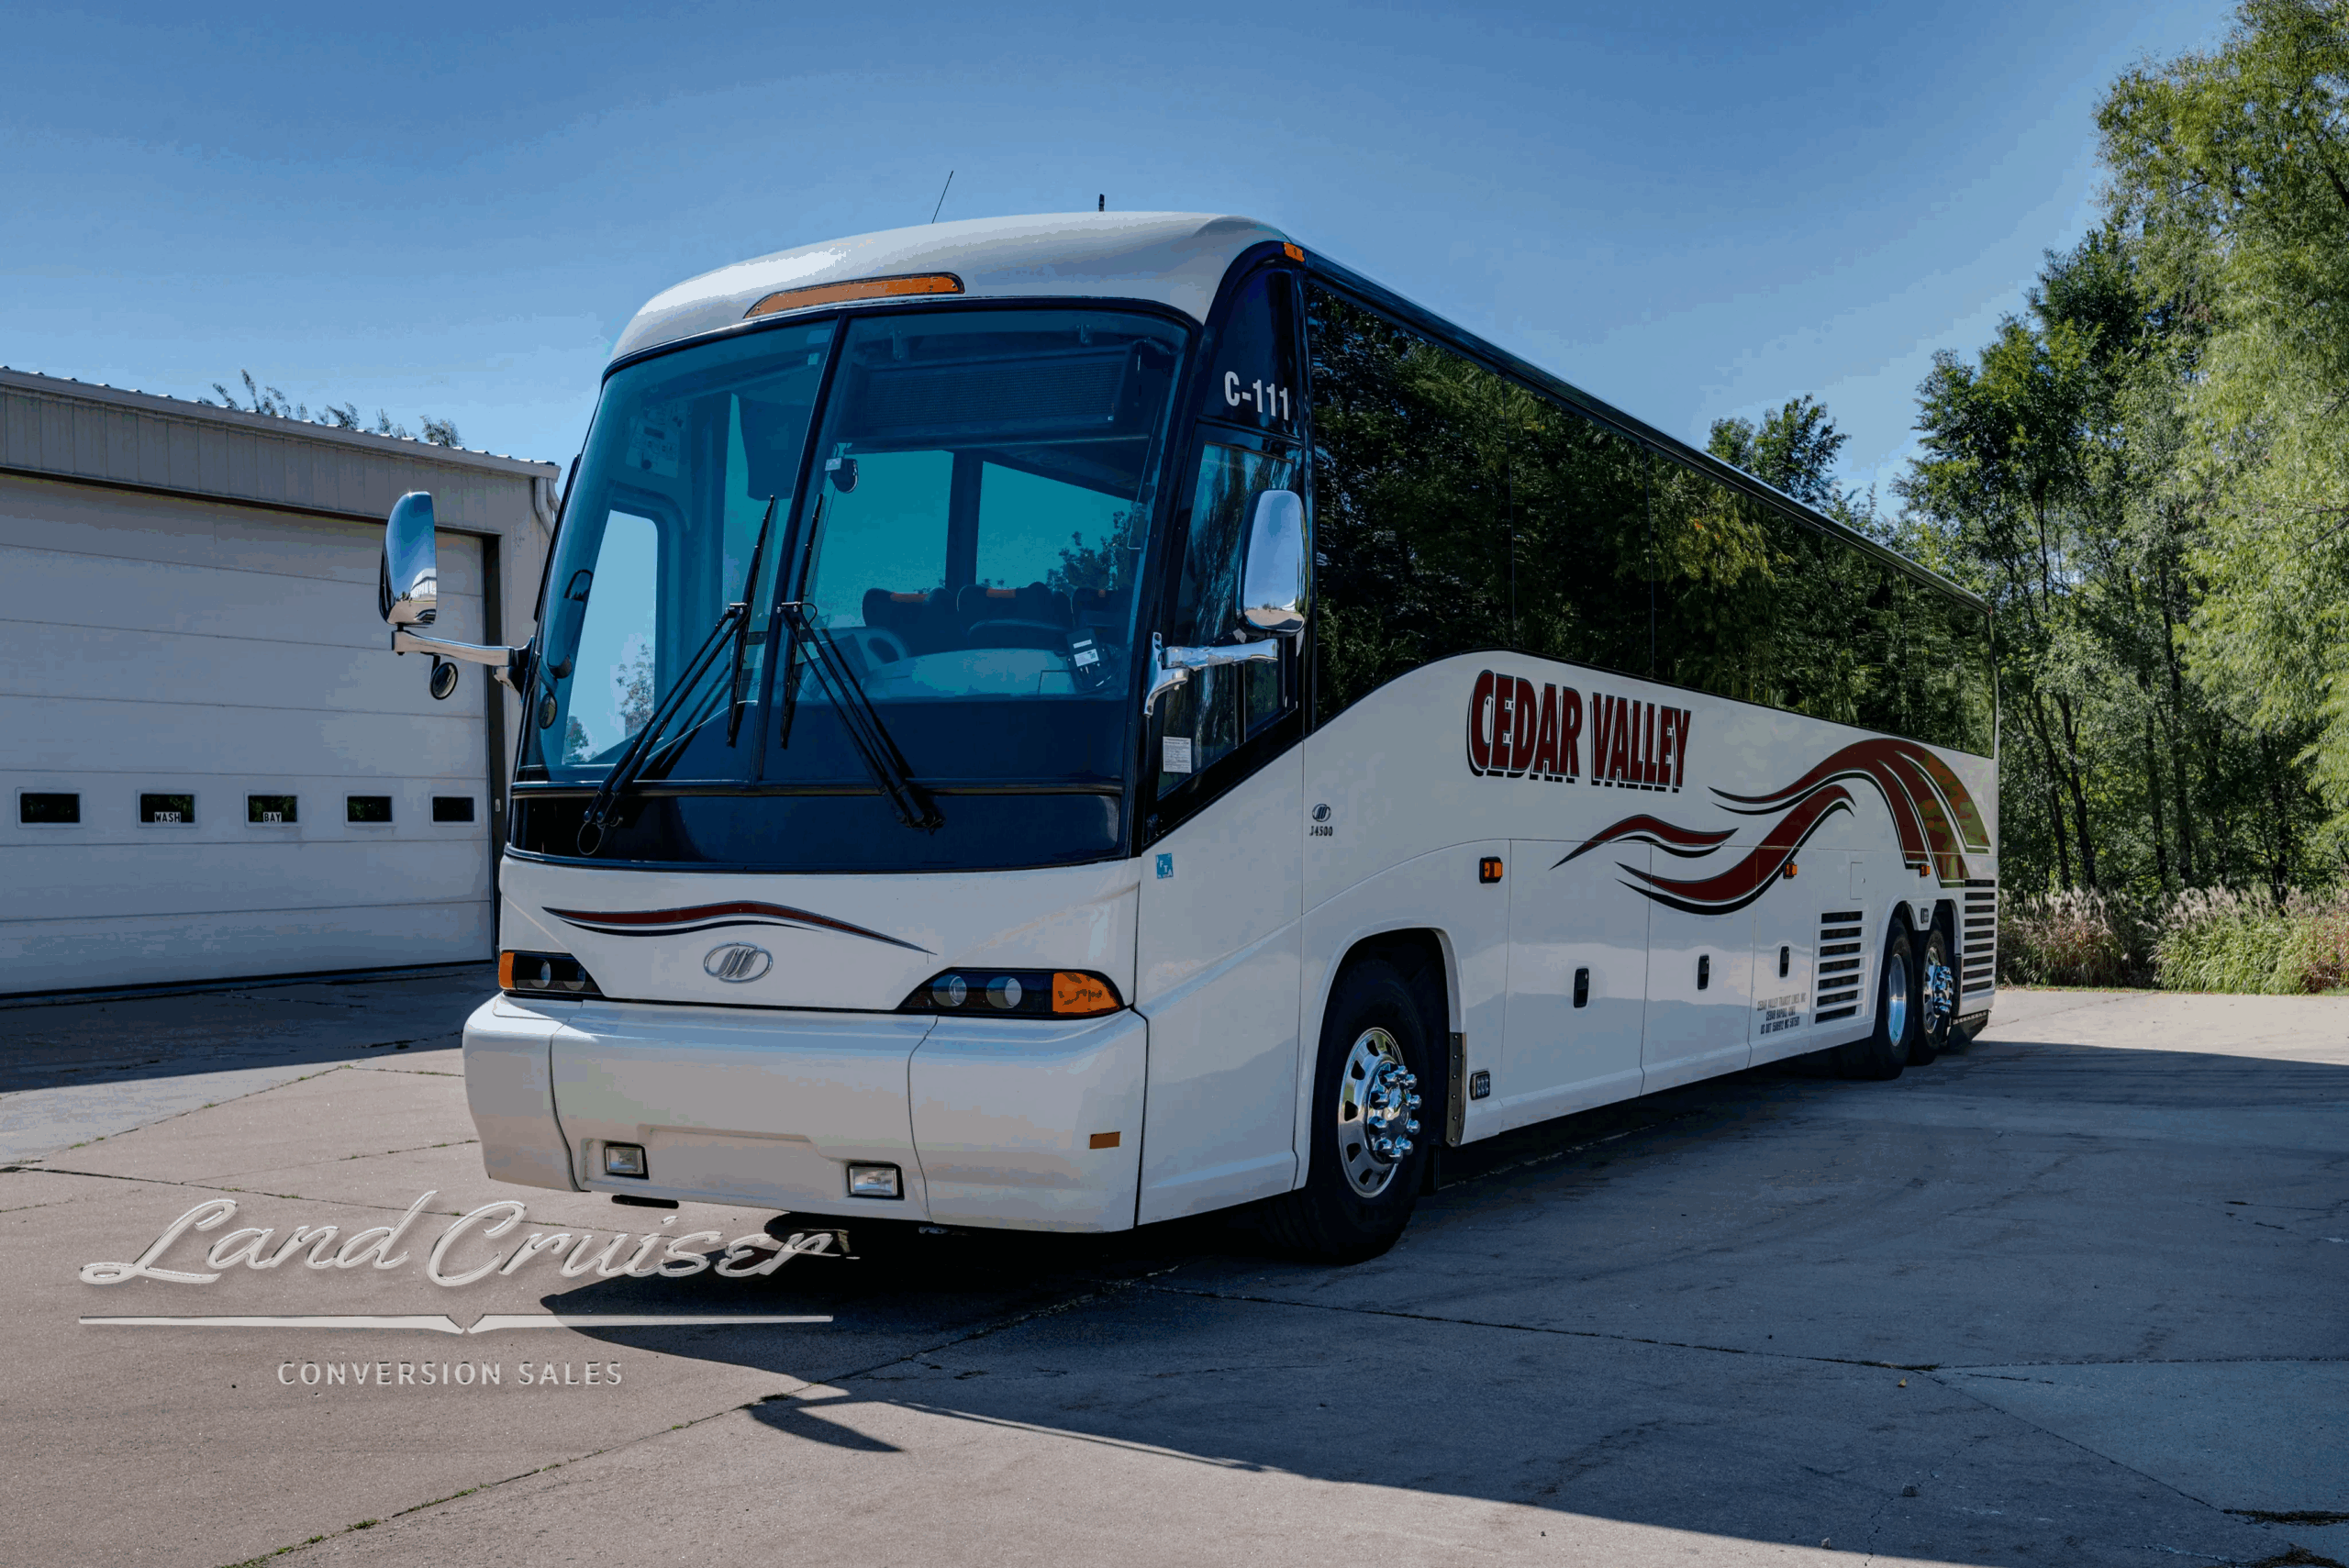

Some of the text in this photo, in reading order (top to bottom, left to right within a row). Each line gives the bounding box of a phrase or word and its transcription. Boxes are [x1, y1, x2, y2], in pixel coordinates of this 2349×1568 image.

[1224, 371, 1289, 421] C-111
[1466, 669, 1692, 793] CEDAR VALLEY
[154, 812, 282, 823] WASH BAY
[1309, 826, 1333, 837] J4500
